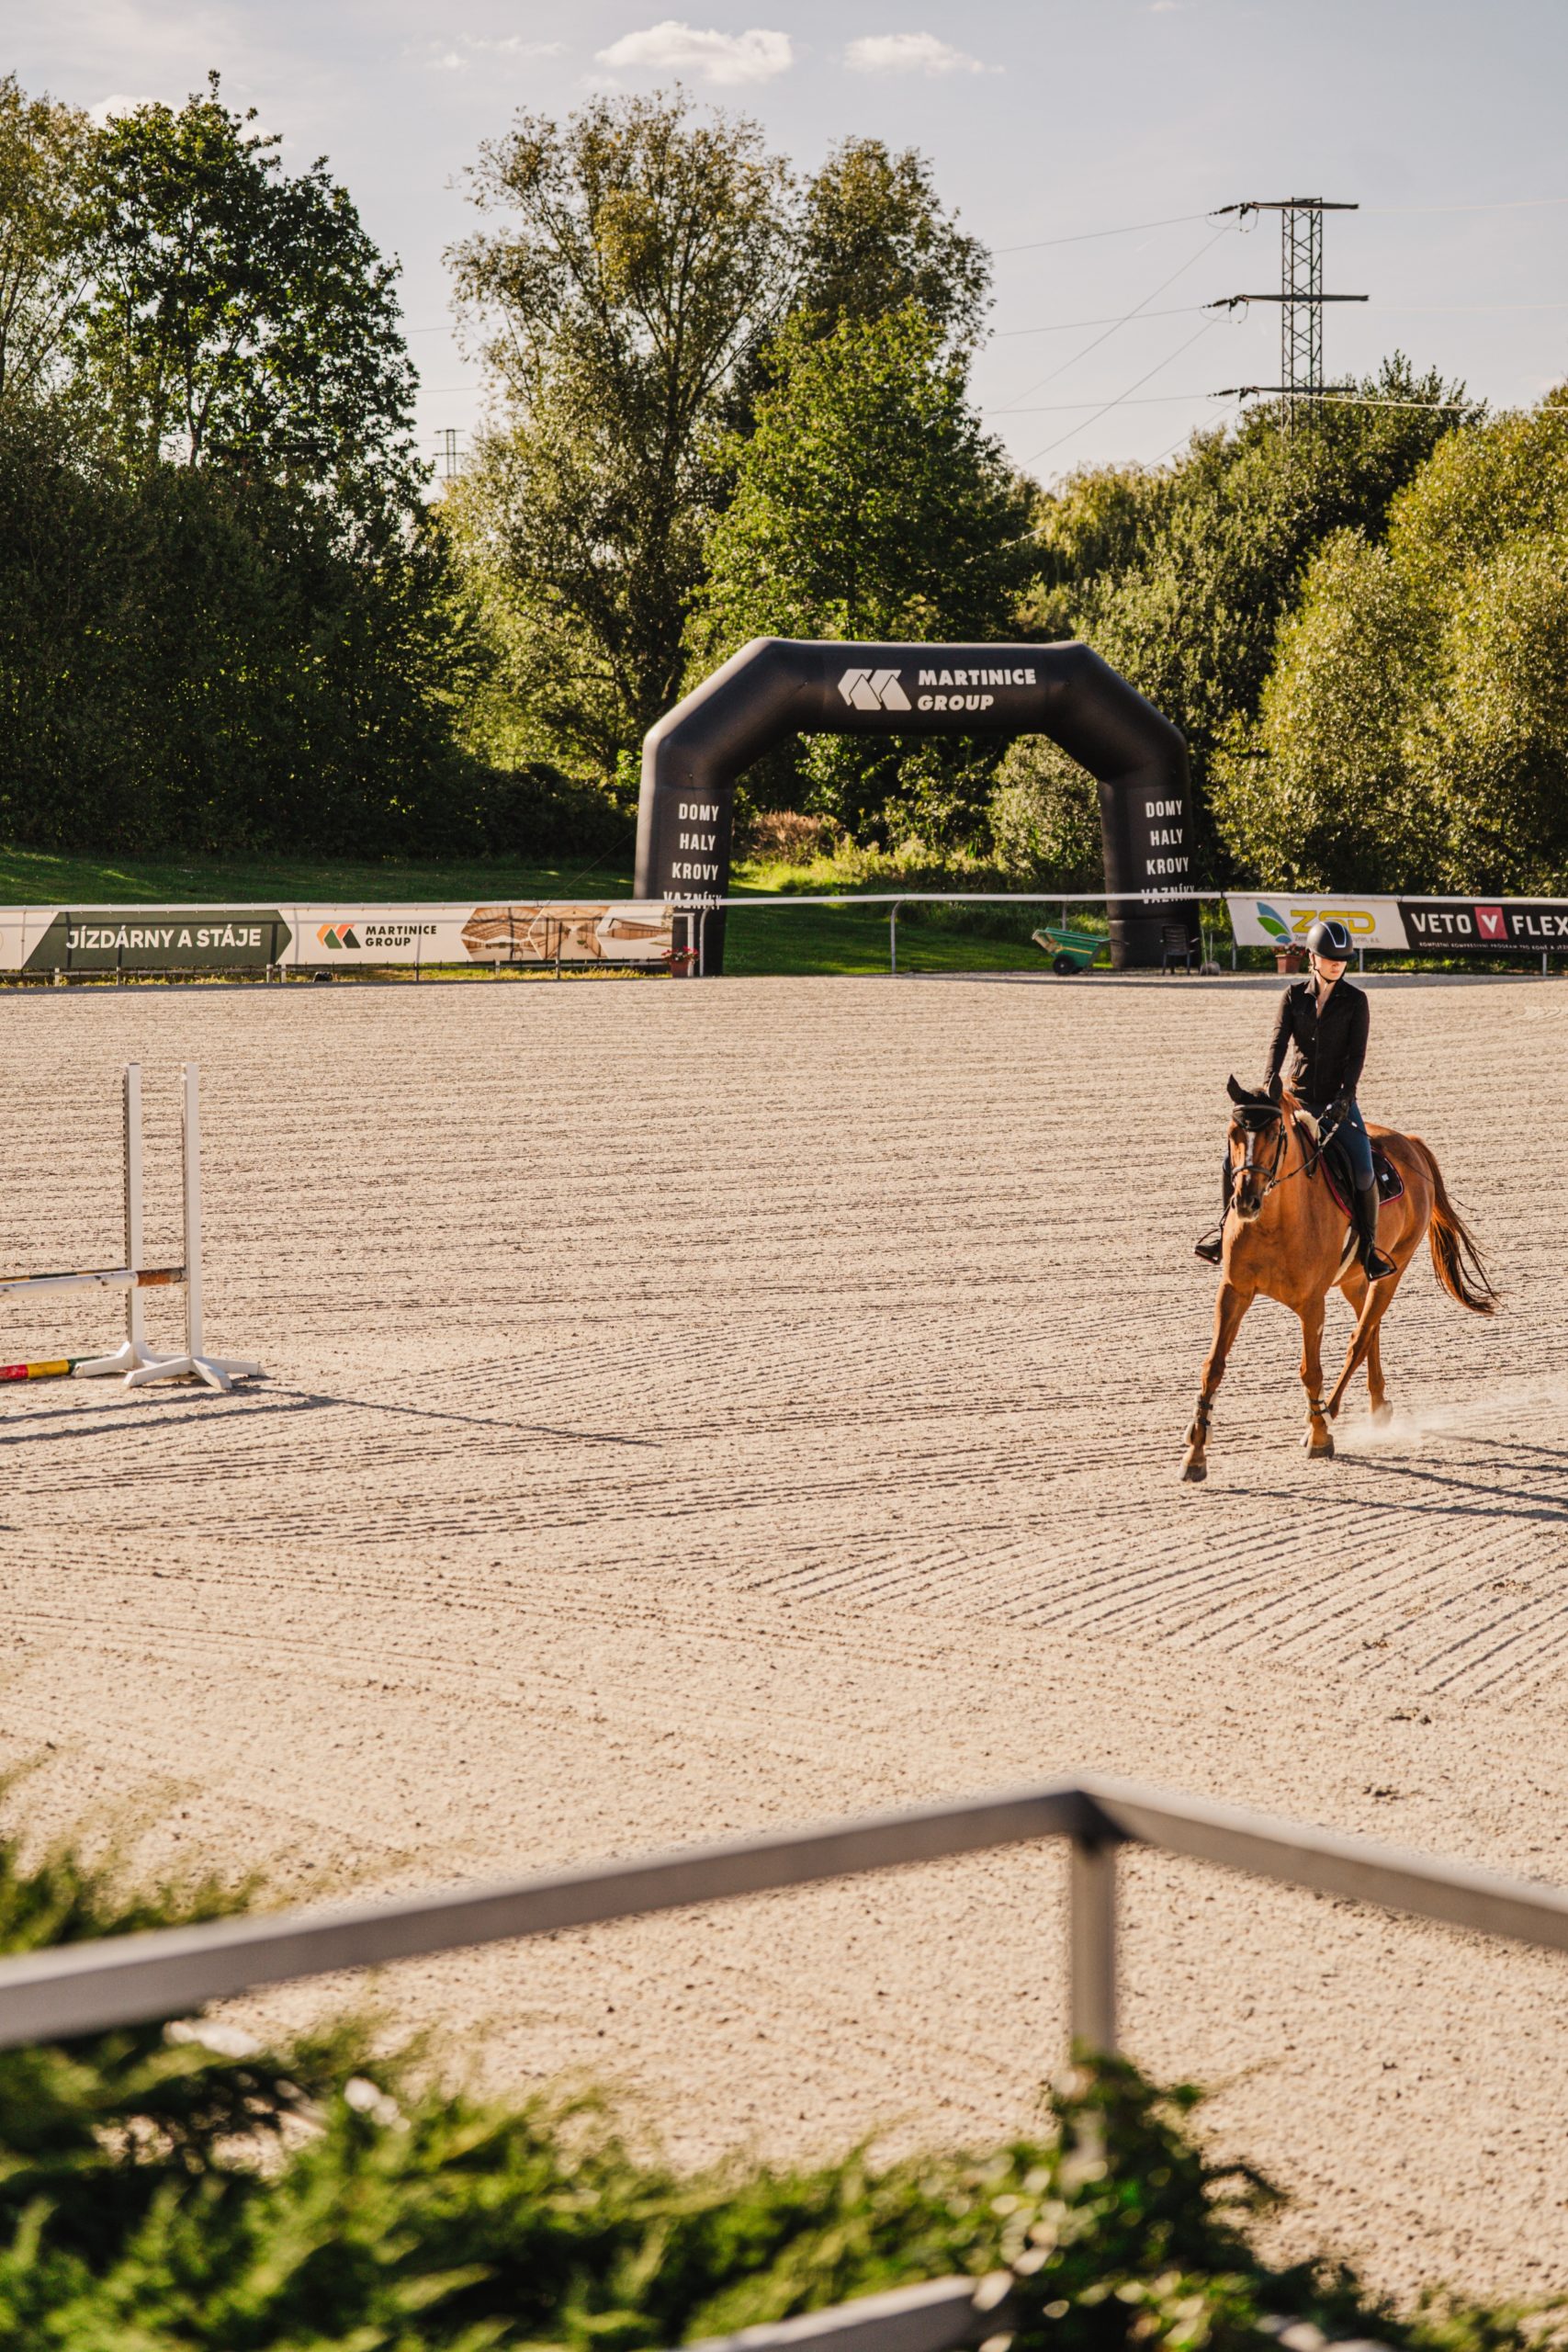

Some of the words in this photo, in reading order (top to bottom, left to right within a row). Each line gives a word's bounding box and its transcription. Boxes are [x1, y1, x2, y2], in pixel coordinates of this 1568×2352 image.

[918, 669, 1036, 686] MARTINICE
[917, 695, 994, 711] GROUP
[678, 803, 719, 821] DOMY
[1145, 800, 1182, 818] DOMY
[680, 833, 716, 851] HALY
[1150, 829, 1182, 846] HALY
[671, 862, 718, 881] KROVY
[1145, 857, 1189, 876] KROVY
[366, 925, 436, 935] MARTINICE
[1411, 913, 1472, 933] VETO
[1512, 915, 1568, 936] FLEX
[66, 925, 175, 948] JÍZDÁRNY
[177, 930, 193, 948] A
[196, 924, 262, 947] STÁJE
[365, 937, 411, 947] GROUP
